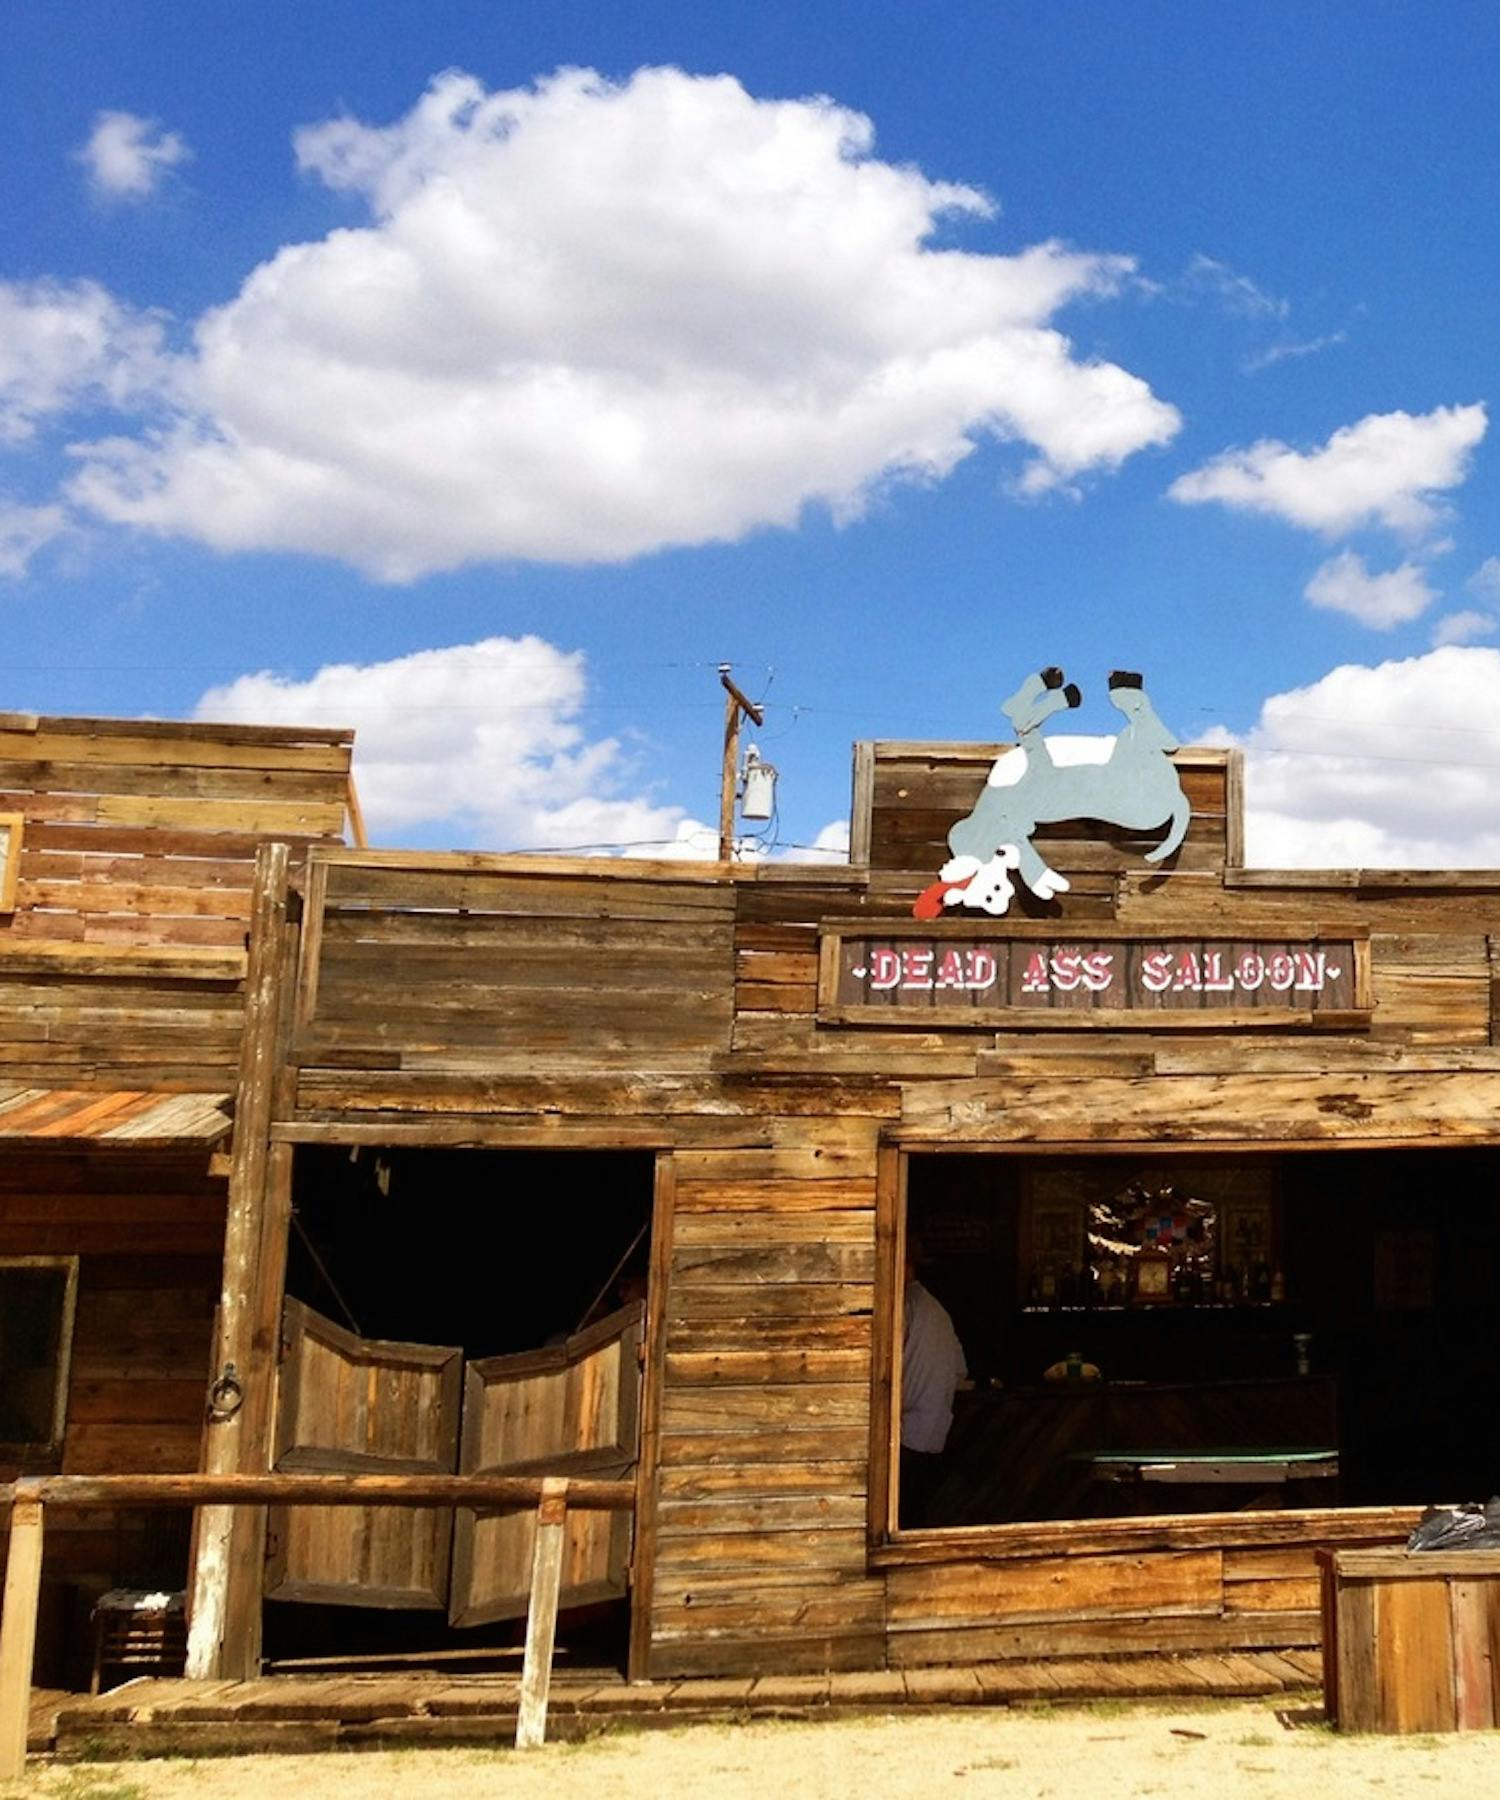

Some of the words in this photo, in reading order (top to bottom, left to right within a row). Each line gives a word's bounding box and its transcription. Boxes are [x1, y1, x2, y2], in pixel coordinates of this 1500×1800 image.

[869, 948, 997, 990] DEAD
[1021, 950, 1113, 991] ASS
[1141, 951, 1326, 992] SALOON
